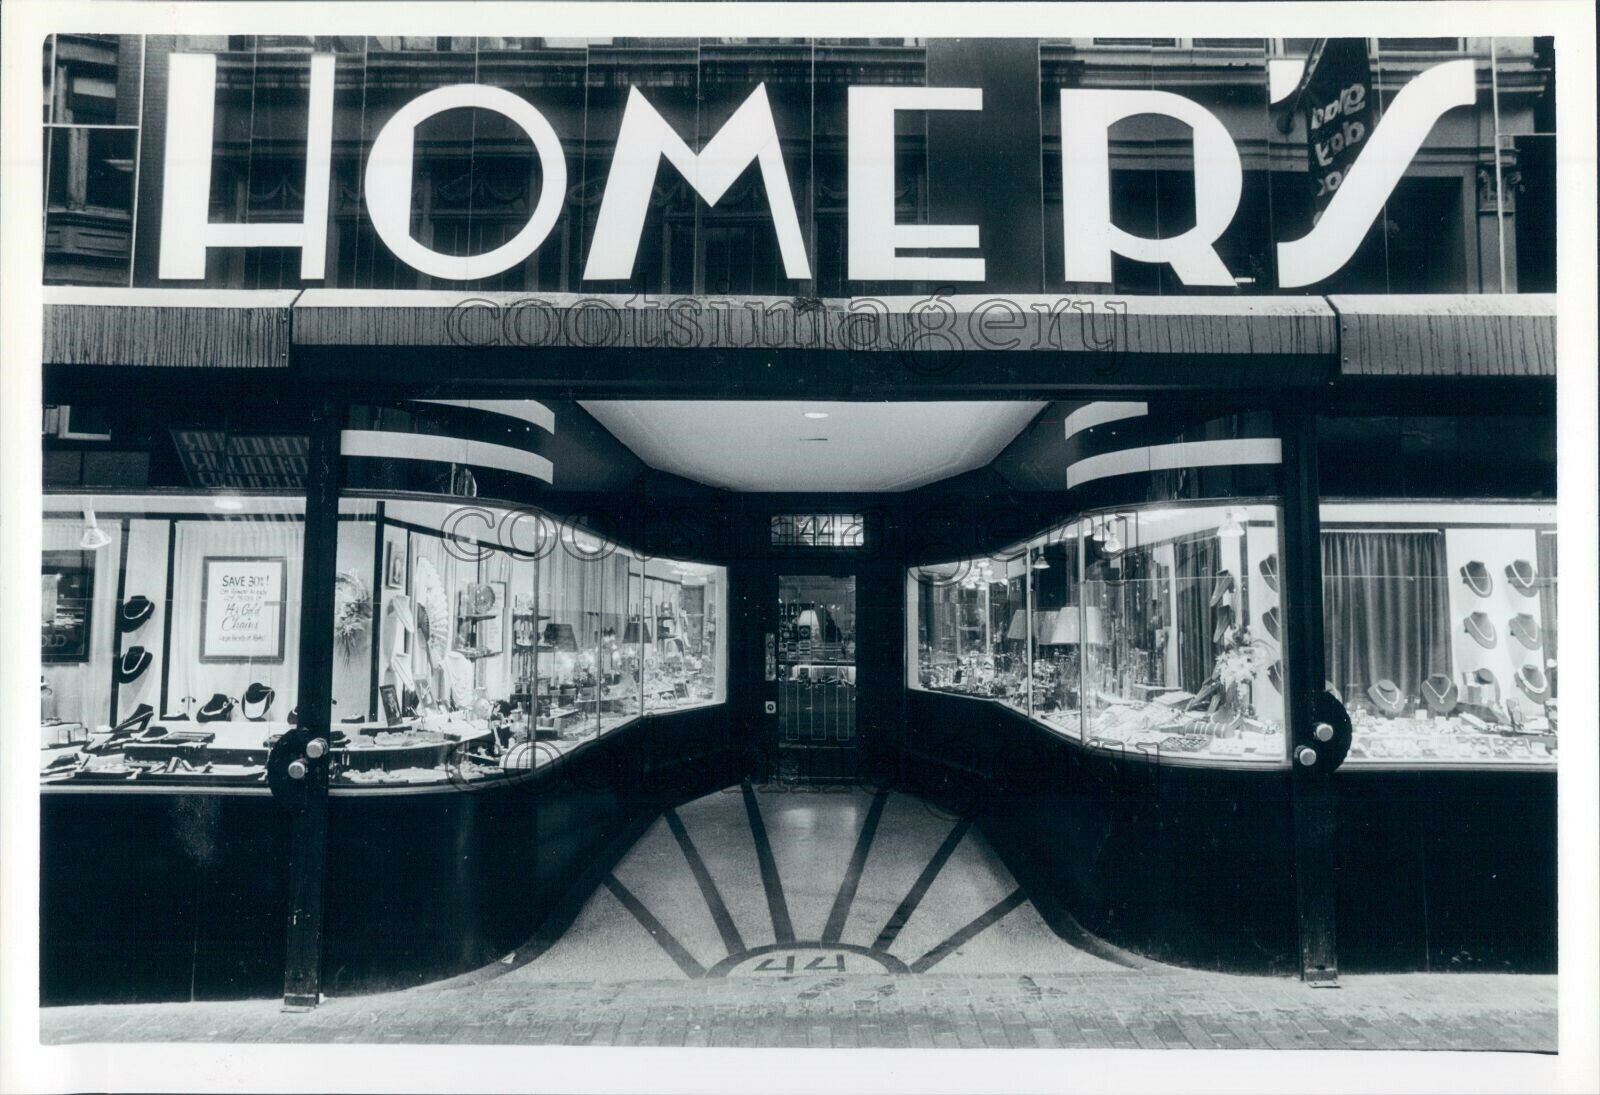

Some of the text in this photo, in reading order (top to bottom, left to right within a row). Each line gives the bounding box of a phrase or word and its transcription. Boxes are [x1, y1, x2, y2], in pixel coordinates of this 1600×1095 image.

[157, 53, 1477, 289] HOMER'S
[222, 575, 246, 588] SAVE
[221, 615, 259, 632] Chains
[753, 954, 846, 974] 44
